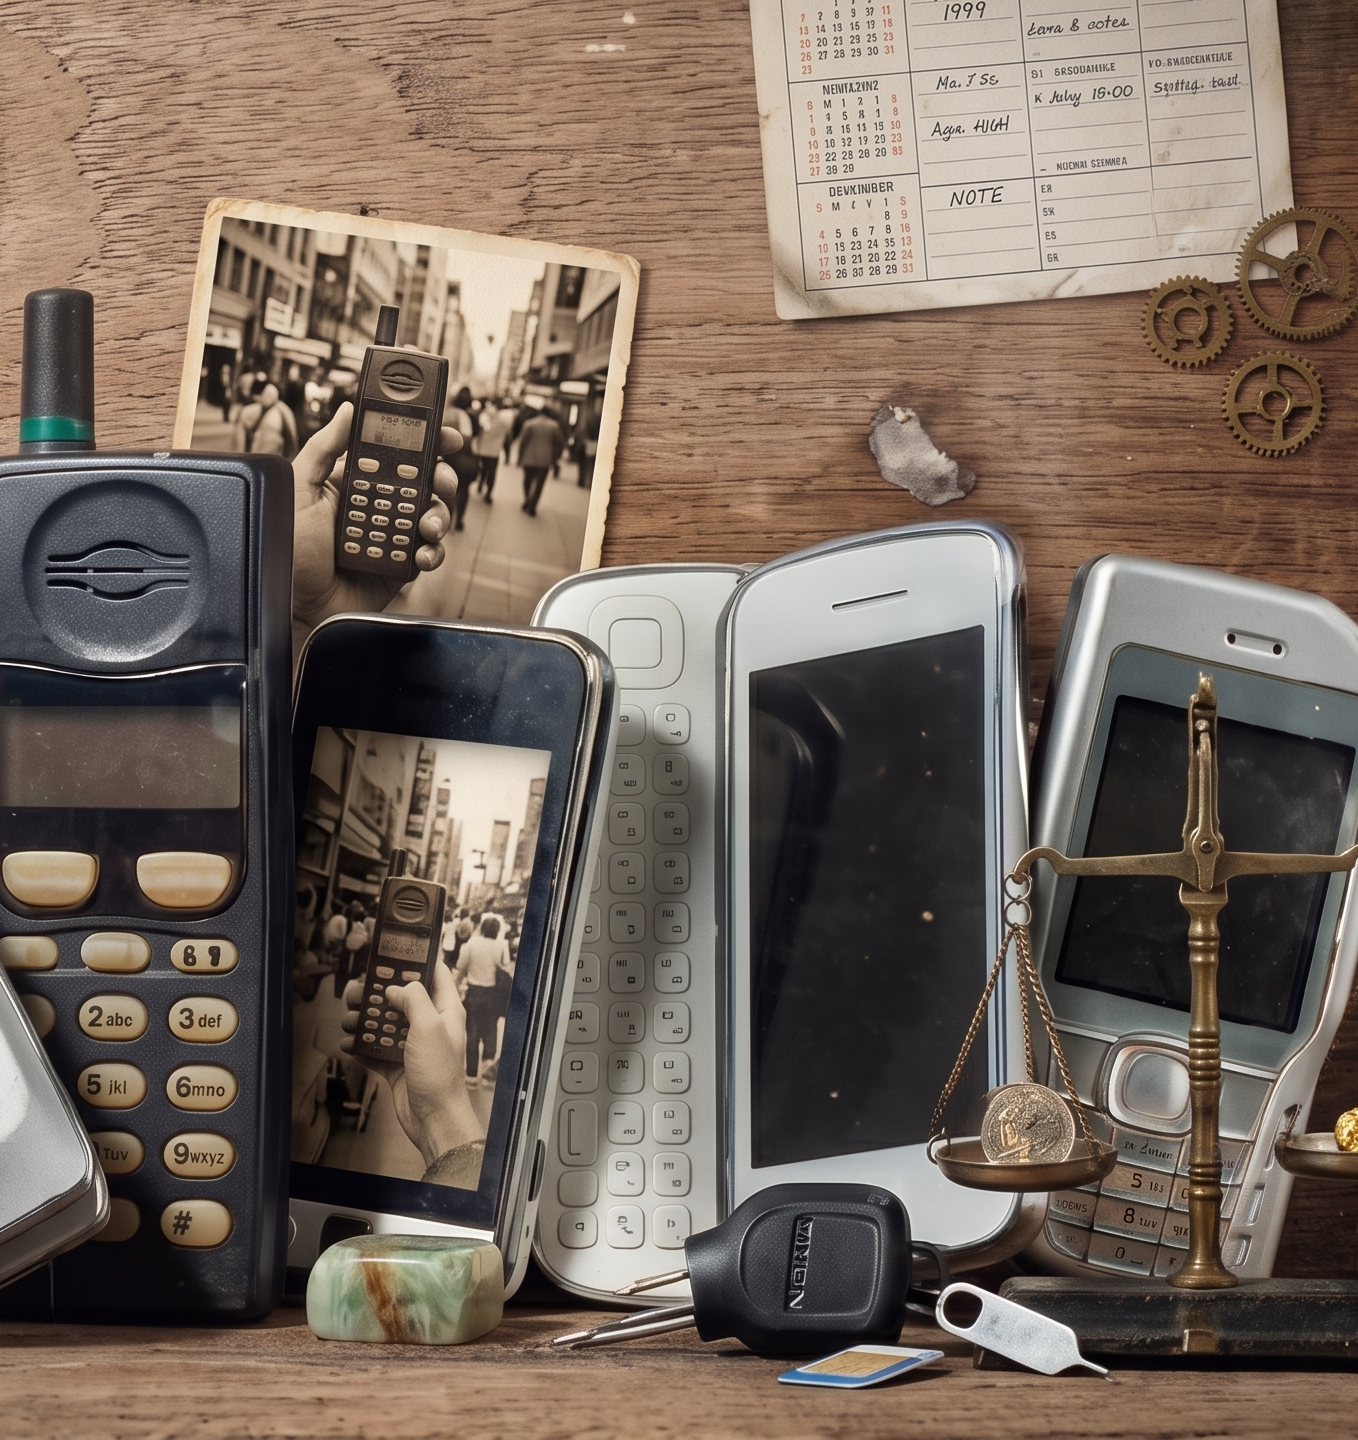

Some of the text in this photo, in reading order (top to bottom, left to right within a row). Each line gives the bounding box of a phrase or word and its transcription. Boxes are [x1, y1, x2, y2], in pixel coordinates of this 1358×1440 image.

[943, 0, 987, 22] 1999
[816, 37, 828, 47] 20
[818, 50, 828, 60] 27
[867, 46, 879, 56] 30
[884, 45, 895, 55] 31
[823, 100, 832, 109] M
[842, 111, 848, 121] 5
[825, 152, 837, 162] 22
[949, 186, 1004, 207] NOTE
[816, 203, 823, 213] S
[831, 202, 840, 212] M
[900, 196, 907, 206] S
[884, 209, 908, 220] 8 9
[819, 230, 825, 240] 4
[835, 228, 842, 239] 5
[852, 227, 858, 237] 6
[868, 225, 875, 236] 7
[885, 224, 892, 234] 8
[850, 240, 862, 251] 23
[867, 238, 879, 249] 24
[868, 252, 880, 263] 20
[884, 250, 896, 261] 22
[901, 249, 913, 260] 24
[819, 270, 831, 280] 25
[836, 268, 848, 279] 26
[868, 265, 881, 276] 28
[885, 264, 898, 274] 29
[1131, 1172, 1143, 1189] 5
[172, 1210, 193, 1236] #
[1123, 1207, 1136, 1224] 8
